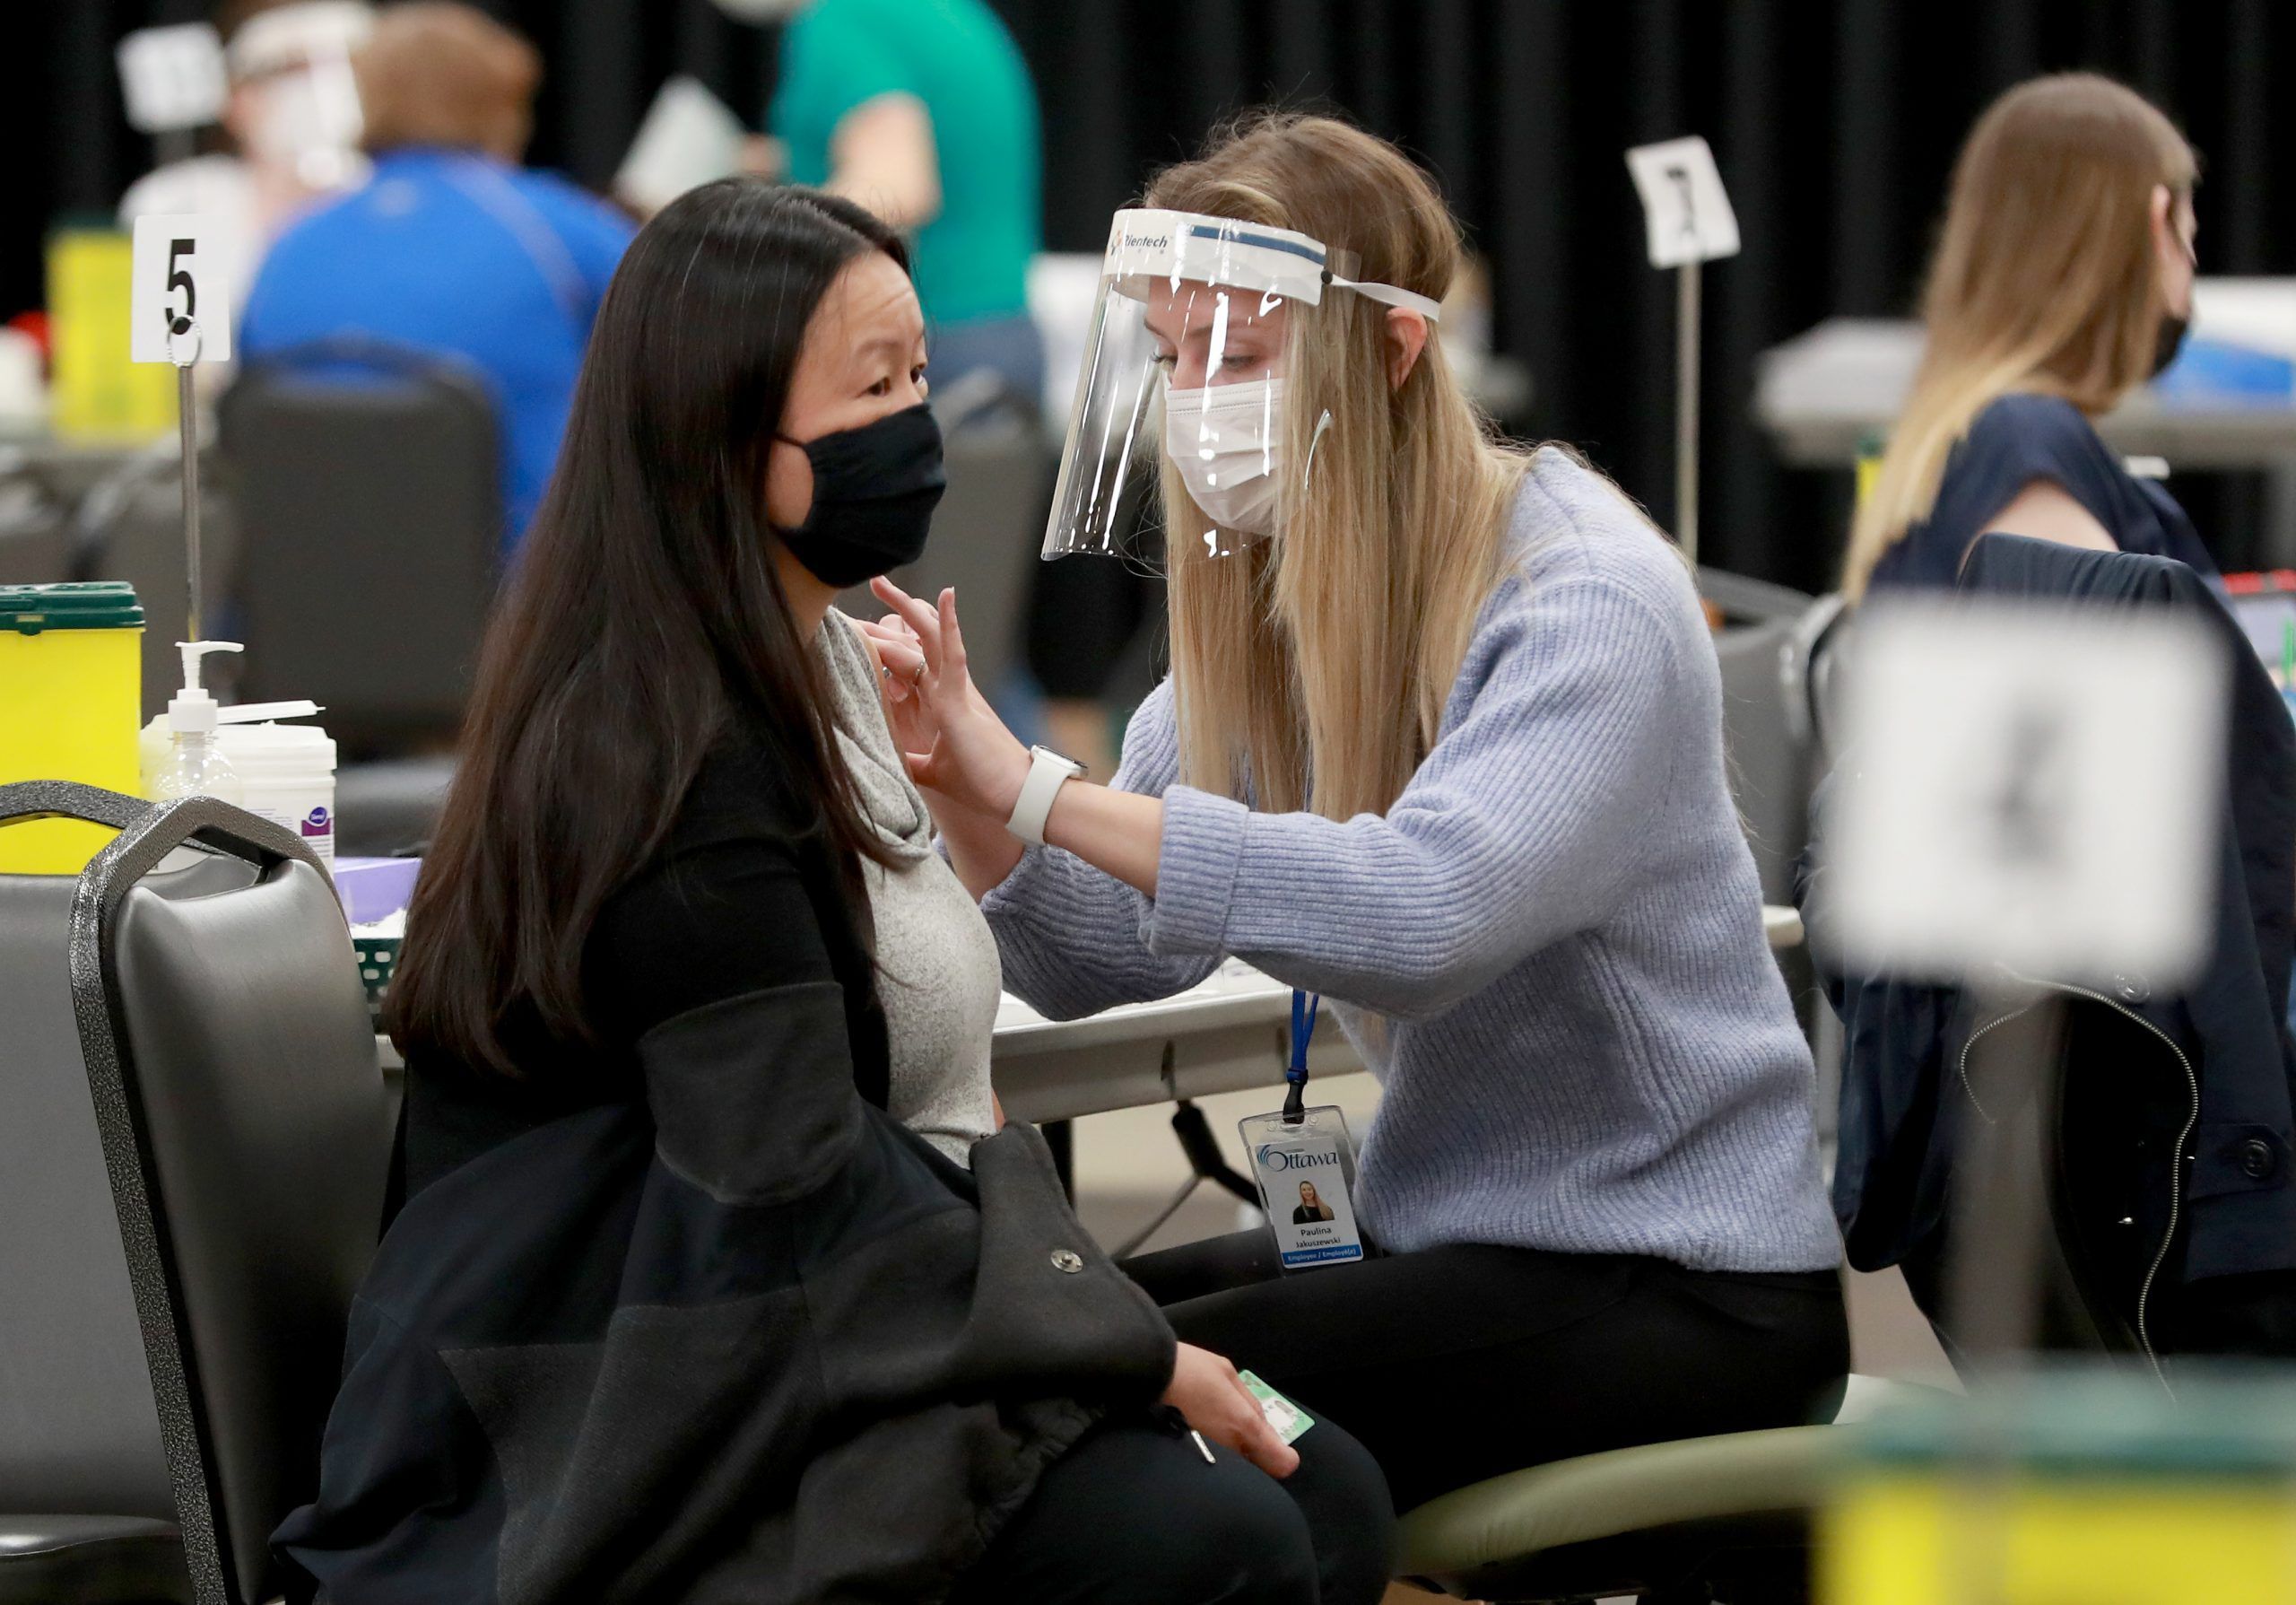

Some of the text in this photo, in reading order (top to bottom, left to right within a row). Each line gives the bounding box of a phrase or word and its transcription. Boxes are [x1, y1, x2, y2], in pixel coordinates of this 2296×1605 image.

[164, 238, 196, 336] 5
[1266, 1151, 1337, 1172] Ottawa
[1300, 1227, 1332, 1236] Paulina
